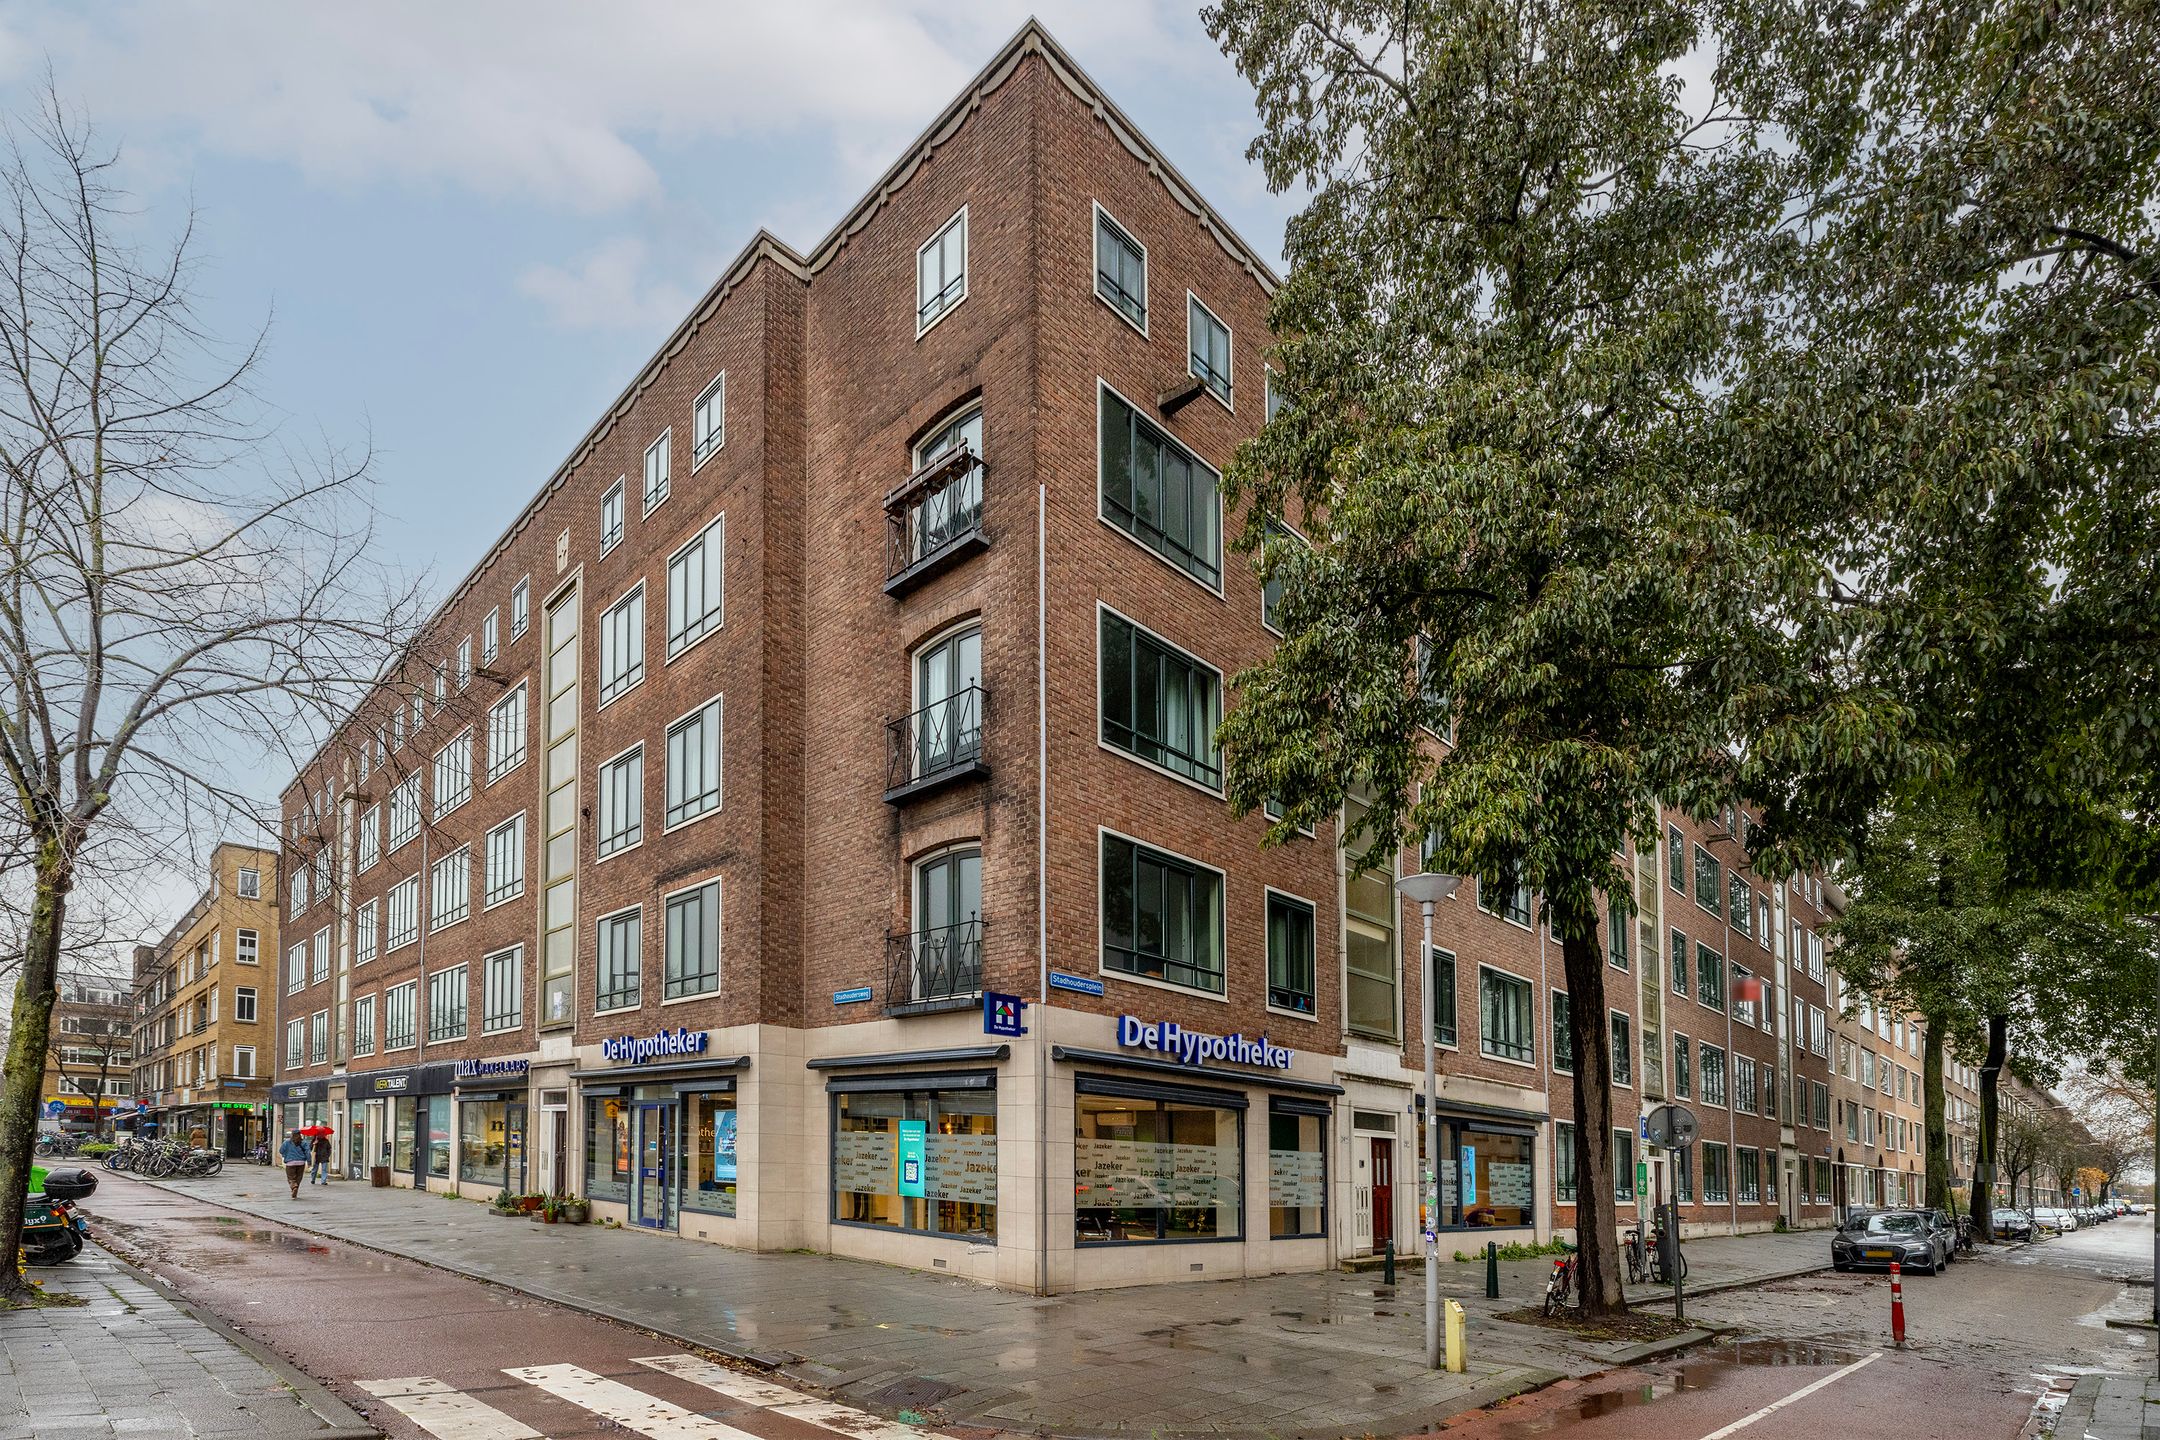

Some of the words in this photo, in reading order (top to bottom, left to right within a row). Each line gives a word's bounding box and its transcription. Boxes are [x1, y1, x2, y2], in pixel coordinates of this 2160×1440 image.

[454, 1059, 478, 1077] max
[479, 1060, 527, 1074] MAKELAARS
[855, 1151, 878, 1160] Jazeker
[925, 1154, 950, 1163] Jazeker
[1094, 1161, 1123, 1171] Jazeker
[1175, 1164, 1200, 1173] Jazeker
[855, 1183, 877, 1192] Jazeker
[960, 1186, 982, 1194] Jazeker
